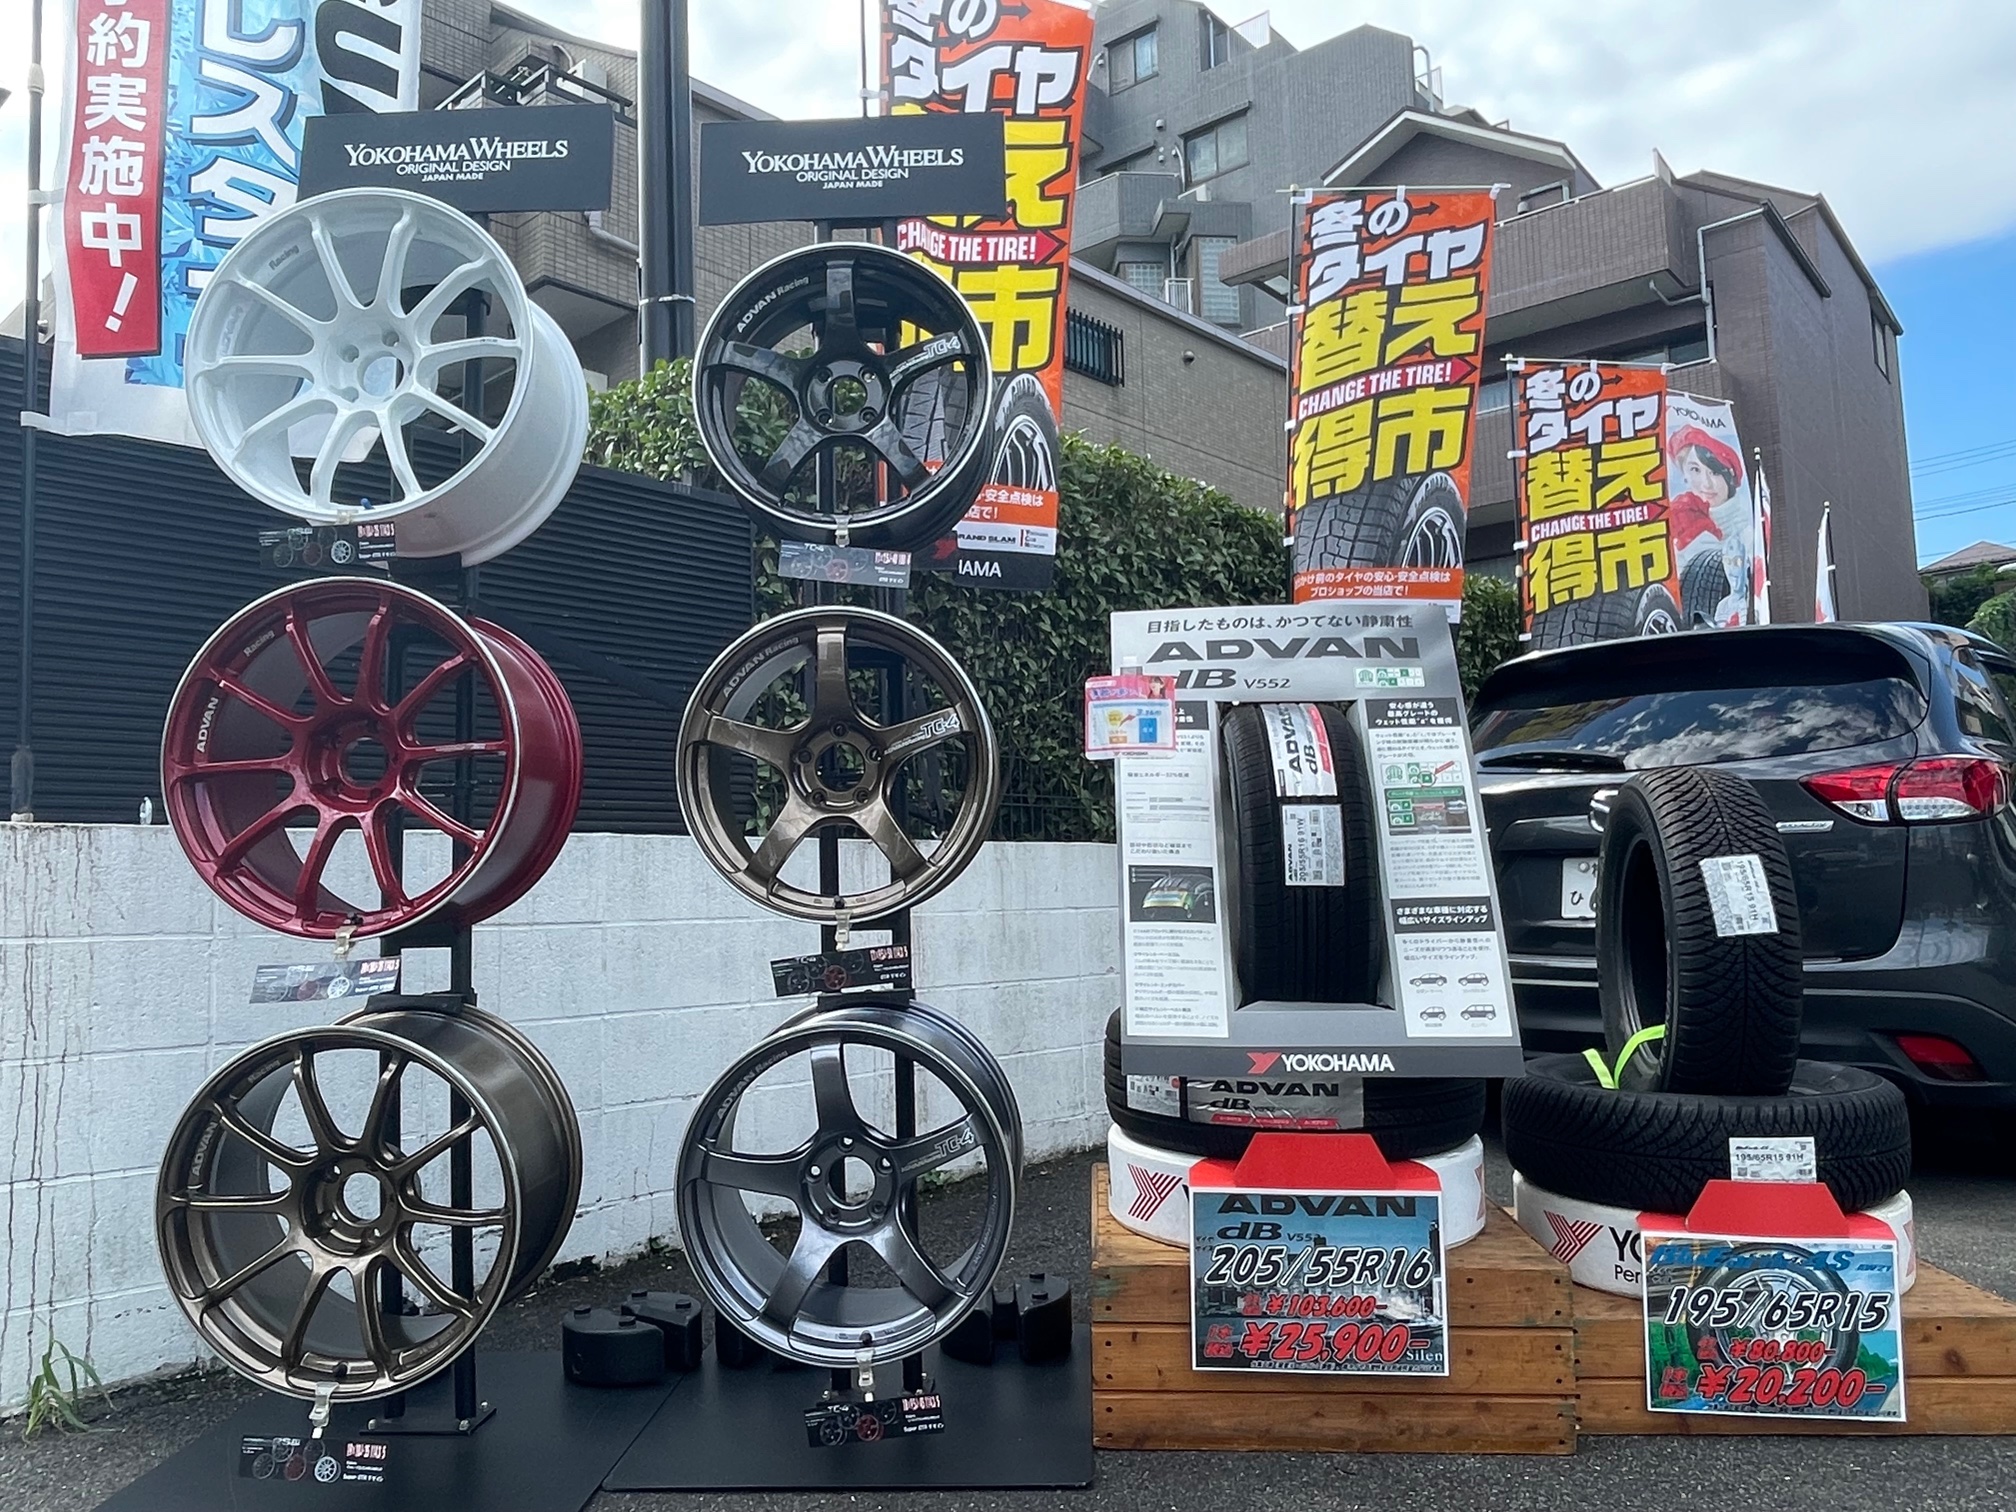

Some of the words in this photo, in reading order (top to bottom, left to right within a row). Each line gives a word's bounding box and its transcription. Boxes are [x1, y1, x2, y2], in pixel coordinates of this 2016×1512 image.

[891, 44, 1079, 115] タイヤ
[79, 0, 151, 333] 約実施中!
[344, 143, 468, 167] YOKOHAMA
[469, 136, 569, 159] WHEELS
[742, 150, 868, 174] YOKOHAMA
[866, 145, 964, 168] WHEELS
[396, 162, 459, 176] ORIGINAL
[462, 160, 511, 172] DESIGN
[421, 173, 454, 182] JAPAN
[456, 172, 484, 181] MADE
[796, 169, 859, 182] ORIGINAL
[861, 168, 909, 180] DESIGN
[822, 181, 854, 190] JAPAN
[856, 180, 884, 188] MADE
[1310, 199, 1410, 250] 冬の
[949, 235, 982, 262] THE
[986, 236, 1037, 263] TIRE!
[1308, 222, 1485, 307] タイヤ
[735, 291, 778, 334] ADVAN
[776, 275, 810, 298] Racing
[1299, 275, 1480, 395] 替え
[1298, 378, 1366, 418] CHANGE
[1368, 369, 1403, 394] THE
[1405, 360, 1452, 387] TIRE!
[1525, 369, 1602, 411] 冬の
[1526, 394, 1660, 455] タイヤ
[1292, 386, 1471, 512] 得市
[1526, 436, 1664, 523] 替え
[988, 534, 1017, 544] SLAM
[1530, 518, 1587, 543] CHANGE
[1588, 511, 1612, 530] THE
[1613, 507, 1650, 528] TIRE!
[1529, 521, 1670, 615] 得市
[1147, 614, 1414, 634] 目指したものは、かつてない静粛性
[243, 628, 276, 658] Racing
[1145, 636, 1422, 664] ADVAN
[721, 651, 766, 698] ADVAN
[765, 635, 800, 658] Racing
[1243, 678, 1292, 690] V552
[195, 696, 220, 754] ADVAN
[921, 712, 961, 739] TC-4
[1281, 1053, 1396, 1073] YOKOHAMA
[1209, 1079, 1340, 1097] ADVAN
[934, 1127, 974, 1158] TC-4
[1217, 1193, 1418, 1218] ADVAN
[1216, 1221, 1283, 1241] dB
[1204, 1244, 1434, 1290] 205/55R16
[1663, 1285, 1893, 1333] 195/65R15
